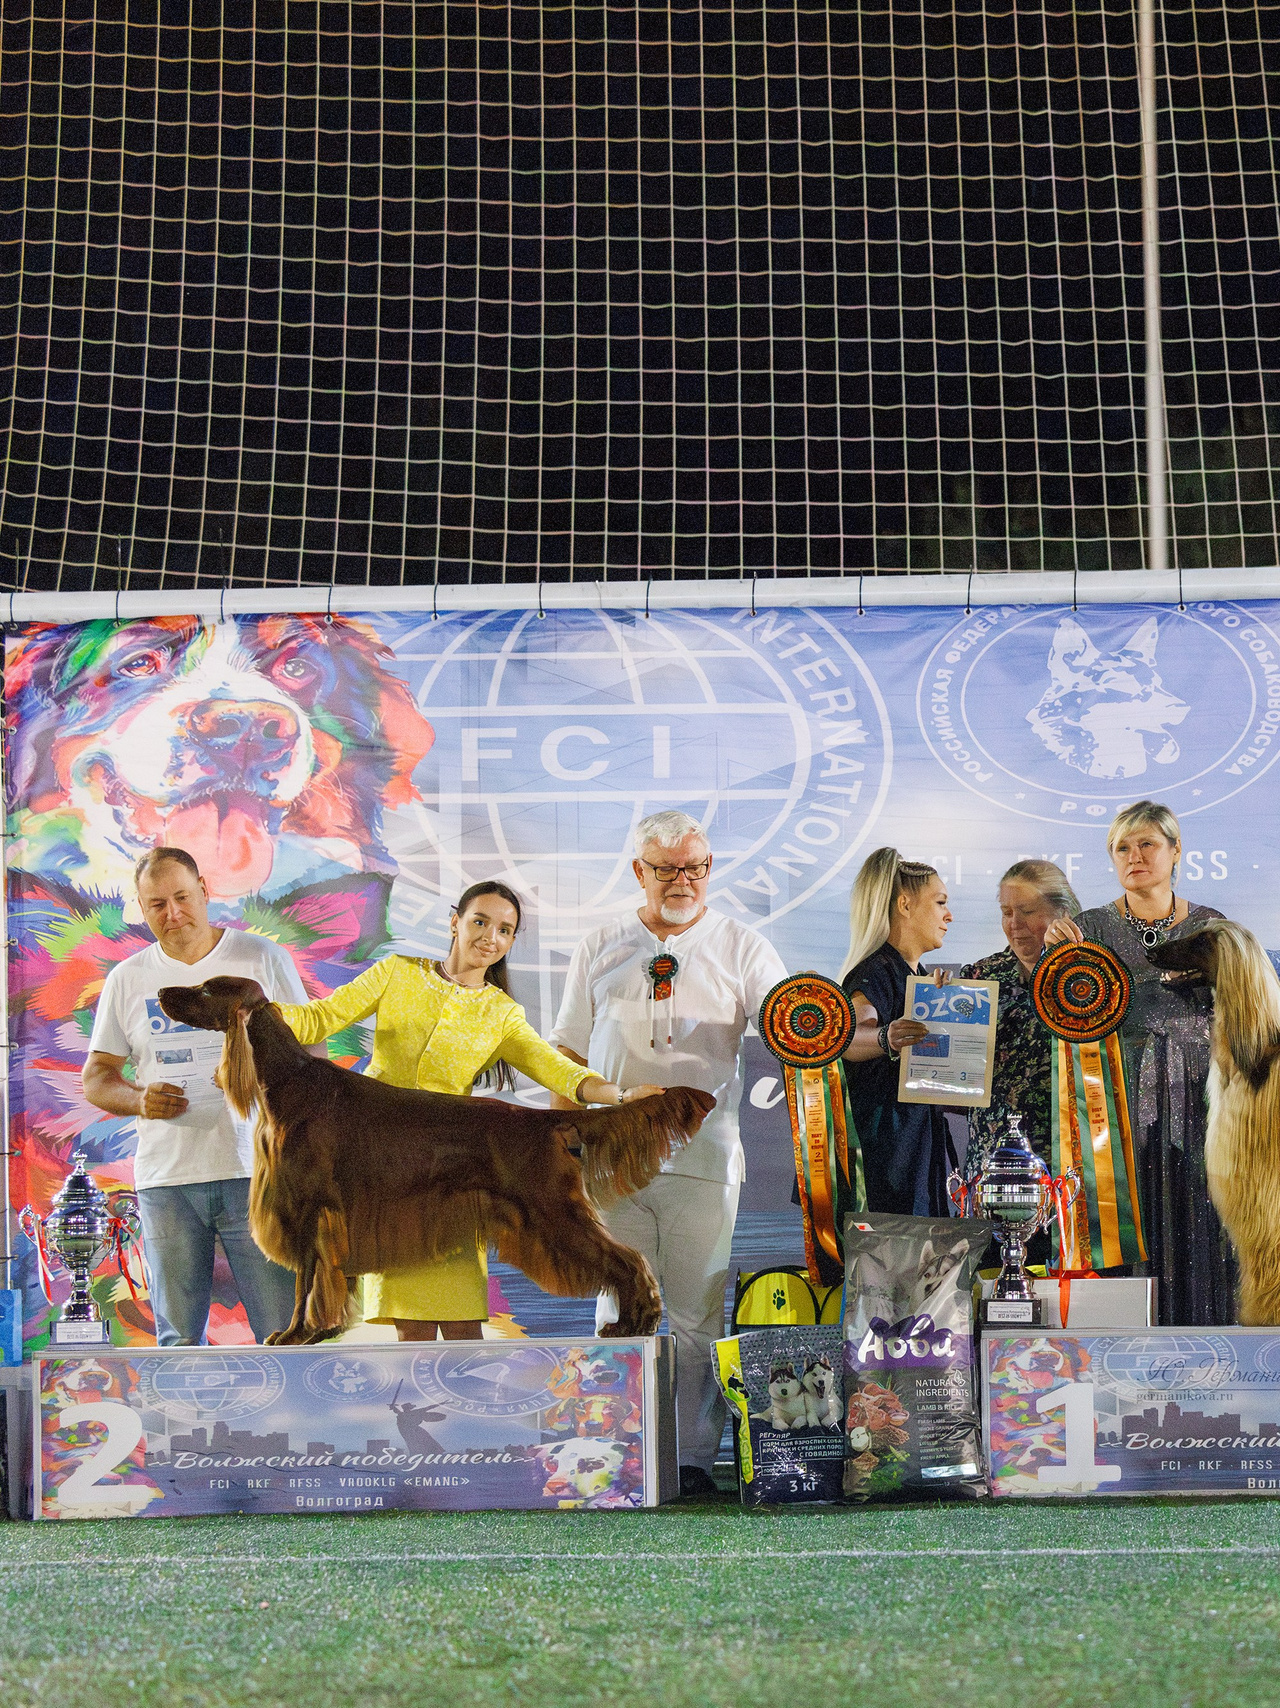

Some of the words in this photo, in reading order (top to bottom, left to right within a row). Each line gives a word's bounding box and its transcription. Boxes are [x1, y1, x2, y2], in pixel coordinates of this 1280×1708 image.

[930, 667, 994, 783] РОССИЙСКАЯ
[461, 724, 671, 782] FCI
[706, 606, 871, 913] INTERNATIONAL
[916, 1388, 969, 1397] INGREDIENTS
[1037, 1382, 1122, 1483] 1
[56, 1401, 154, 1504] 2
[1160, 1459, 1181, 1471] FCI
[1198, 1459, 1222, 1470] RKF
[209, 1479, 230, 1490] FCI
[247, 1478, 272, 1489] RKF
[404, 1475, 470, 1487] «EMANG»
[789, 1480, 798, 1492] 3
[295, 1494, 384, 1509] Волгоград
